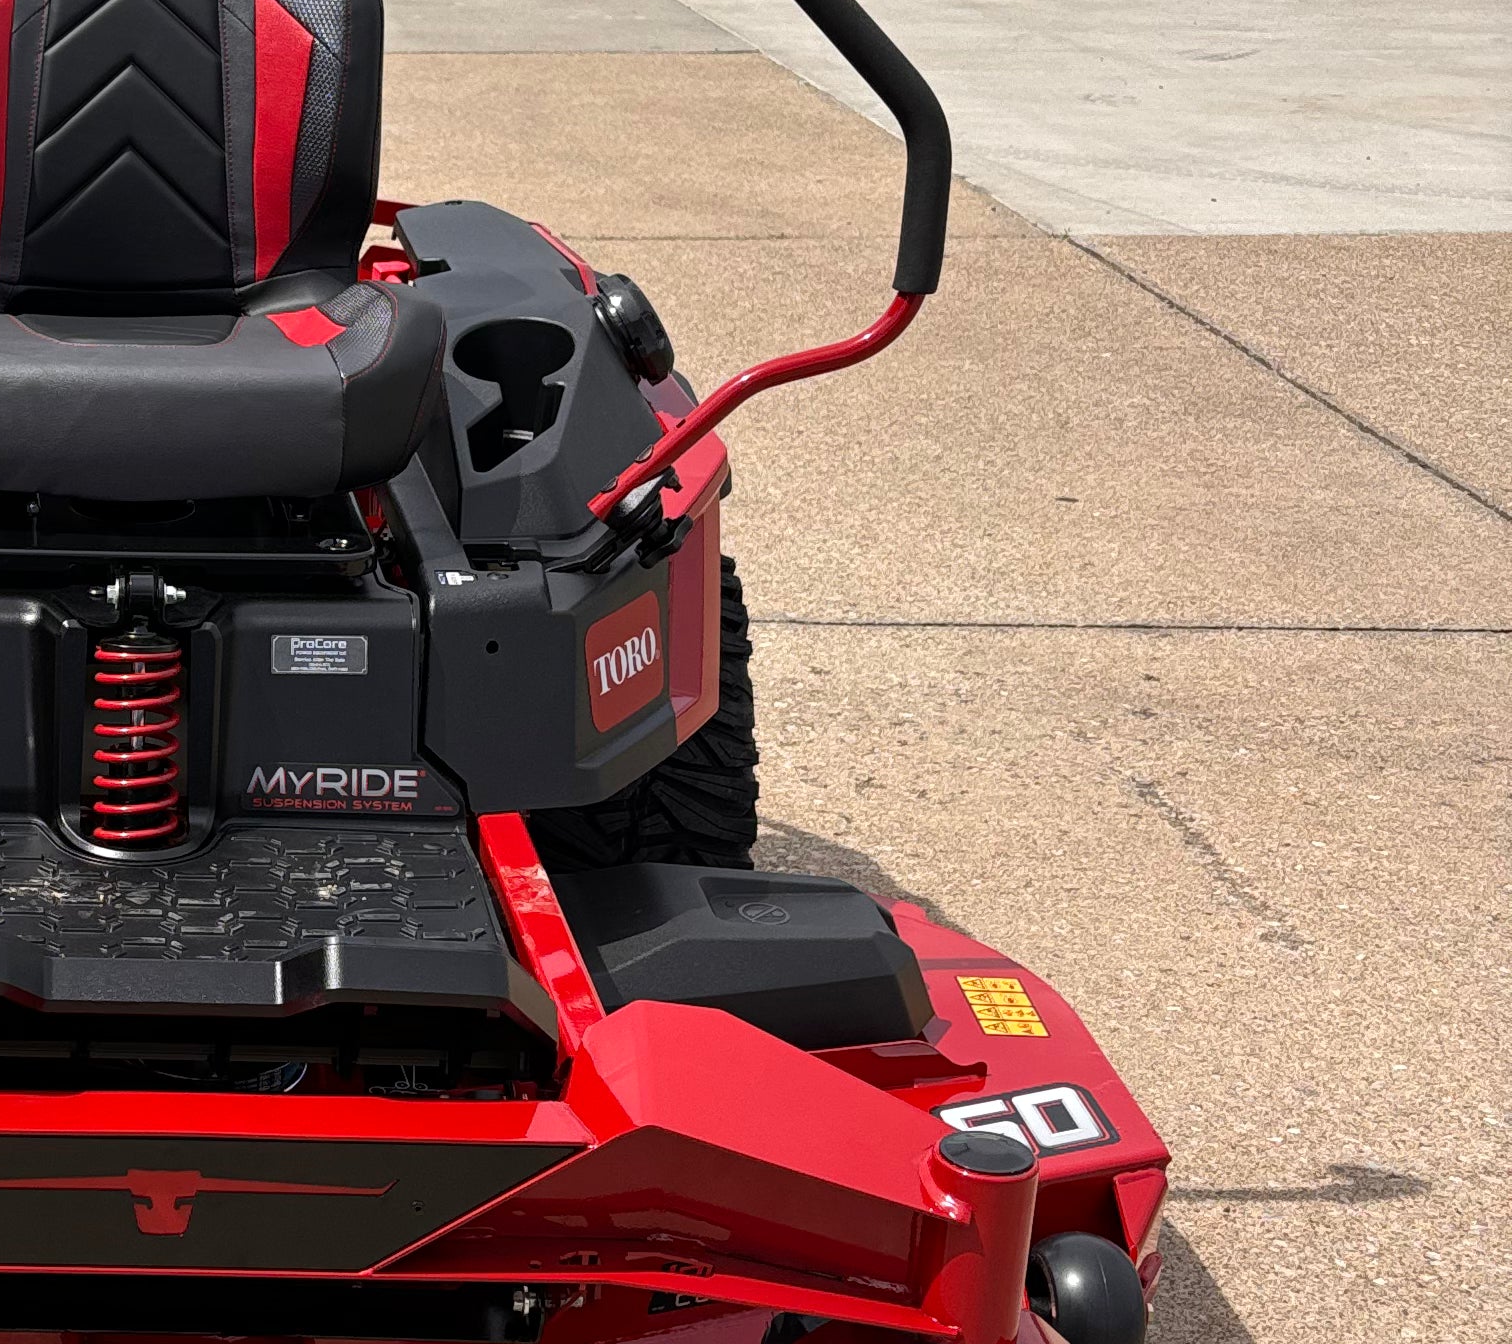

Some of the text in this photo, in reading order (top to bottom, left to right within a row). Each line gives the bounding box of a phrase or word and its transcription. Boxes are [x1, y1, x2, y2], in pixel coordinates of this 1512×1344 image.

[593, 626, 657, 696] TORO
[253, 798, 412, 811] SUSPENSION SYSTEM
